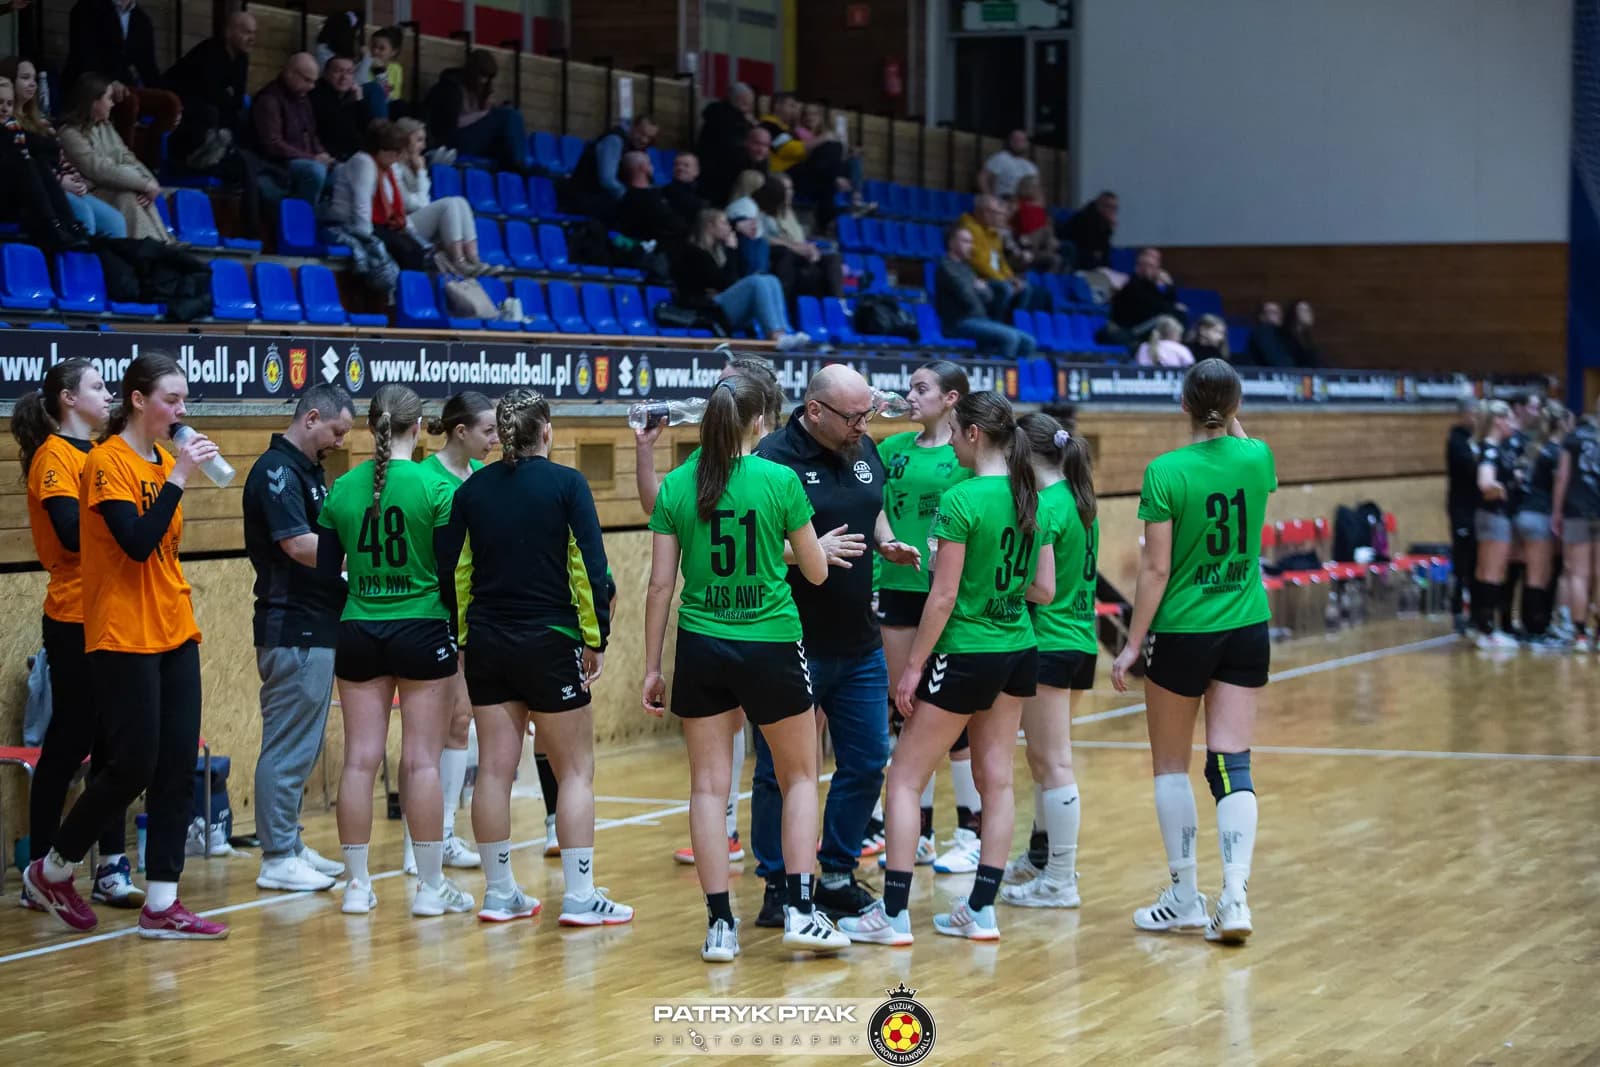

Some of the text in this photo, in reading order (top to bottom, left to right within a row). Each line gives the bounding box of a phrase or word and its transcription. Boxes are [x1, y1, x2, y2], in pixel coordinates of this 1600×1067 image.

[369, 348, 572, 396] www.koronahandball.pl
[357, 505, 408, 569] 48
[710, 509, 757, 578] 51
[1205, 487, 1247, 557] 31
[995, 526, 1035, 591] 34
[1194, 560, 1250, 585] AZS AWF
[359, 575, 413, 597] AZS AWF
[704, 584, 766, 609] AZS AWF
[713, 609, 757, 620] WARSZAWA
